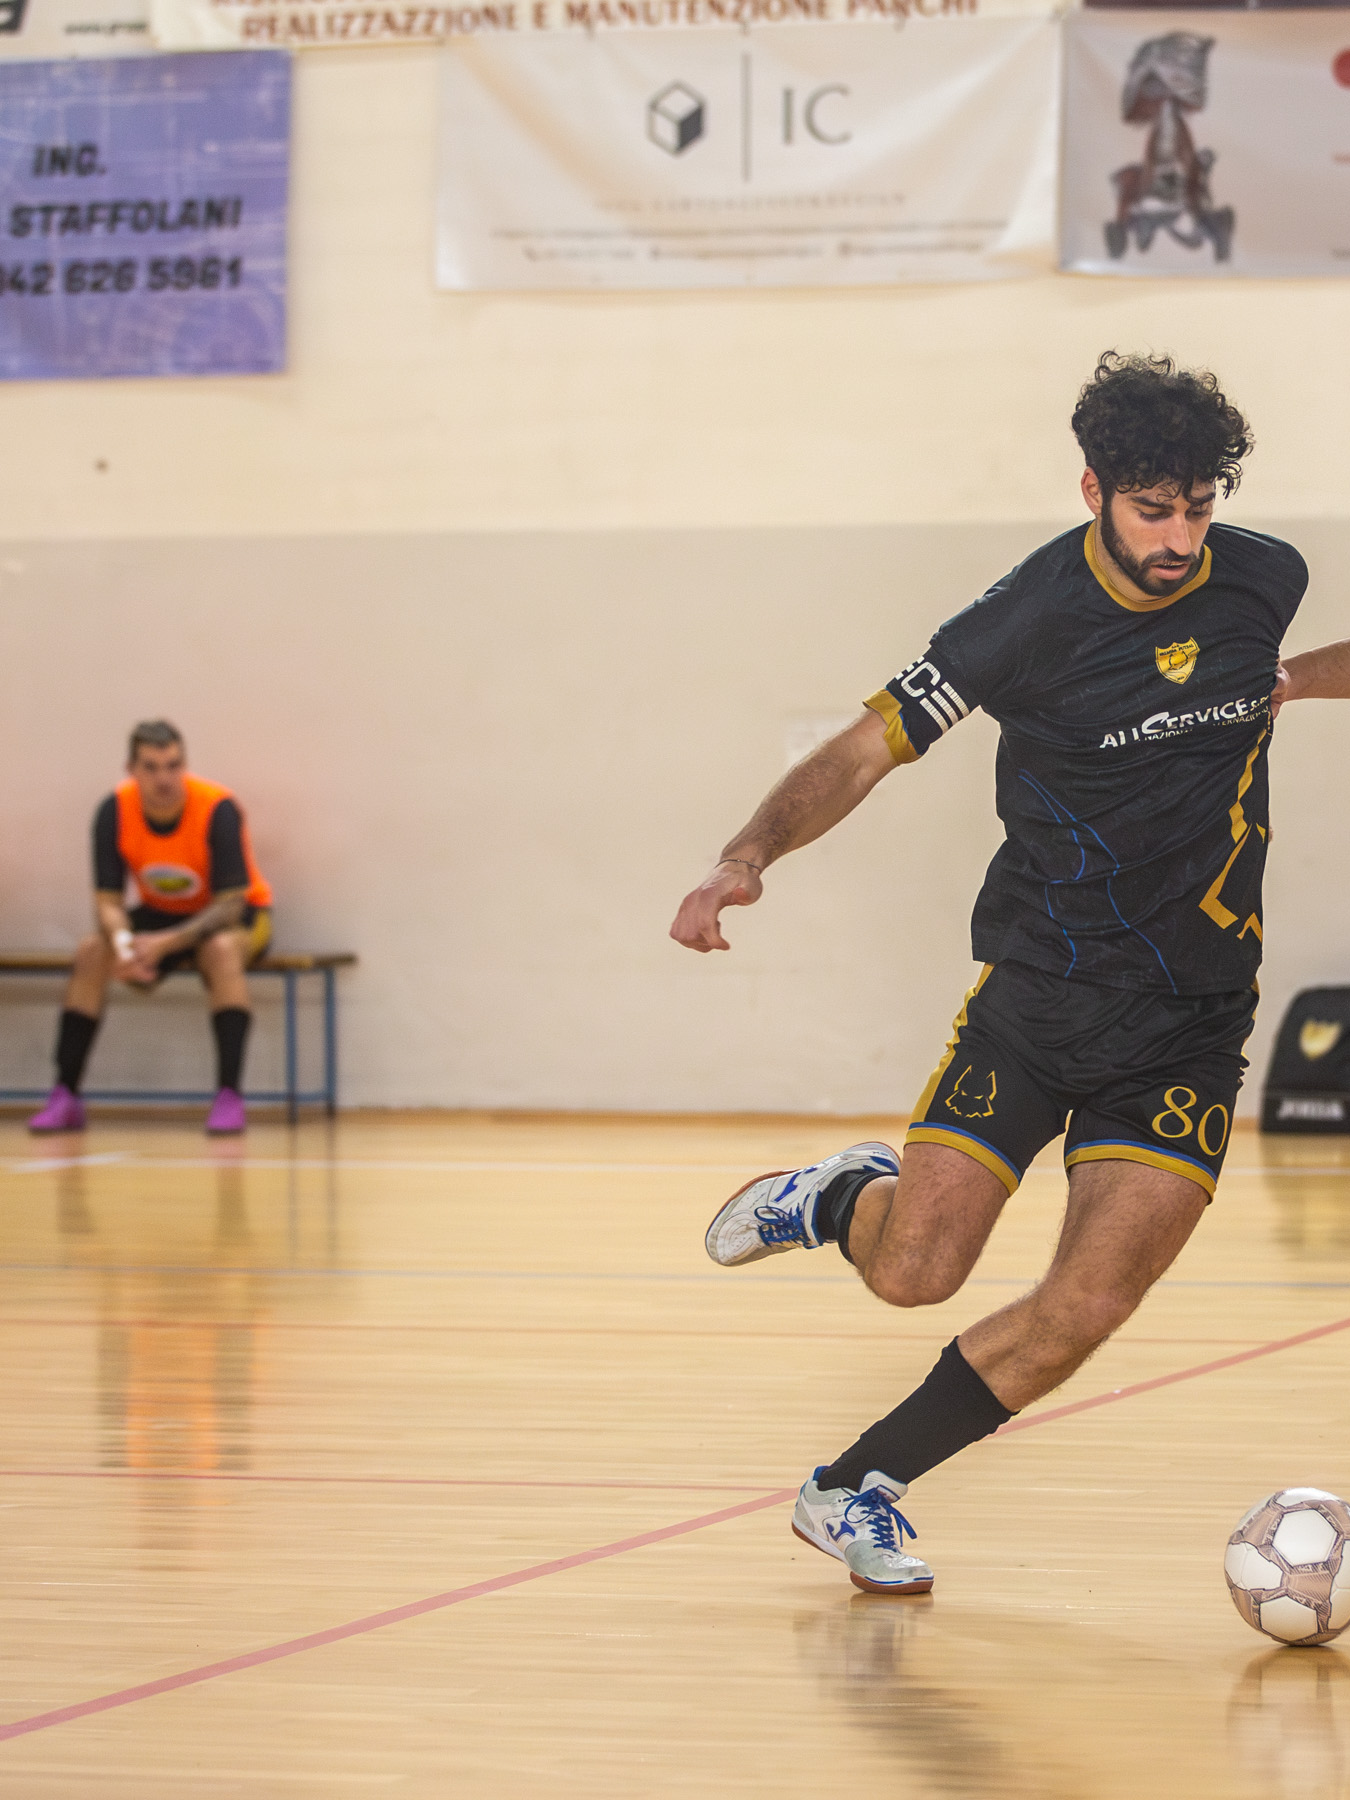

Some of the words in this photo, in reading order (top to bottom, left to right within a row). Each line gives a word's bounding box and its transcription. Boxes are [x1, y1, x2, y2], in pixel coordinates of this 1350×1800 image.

[782, 84, 854, 147] IC
[32, 142, 107, 179] ING.
[10, 196, 243, 237] STAFFOLANI
[64, 258, 136, 294] 626
[1152, 1086, 1228, 1156] 80
